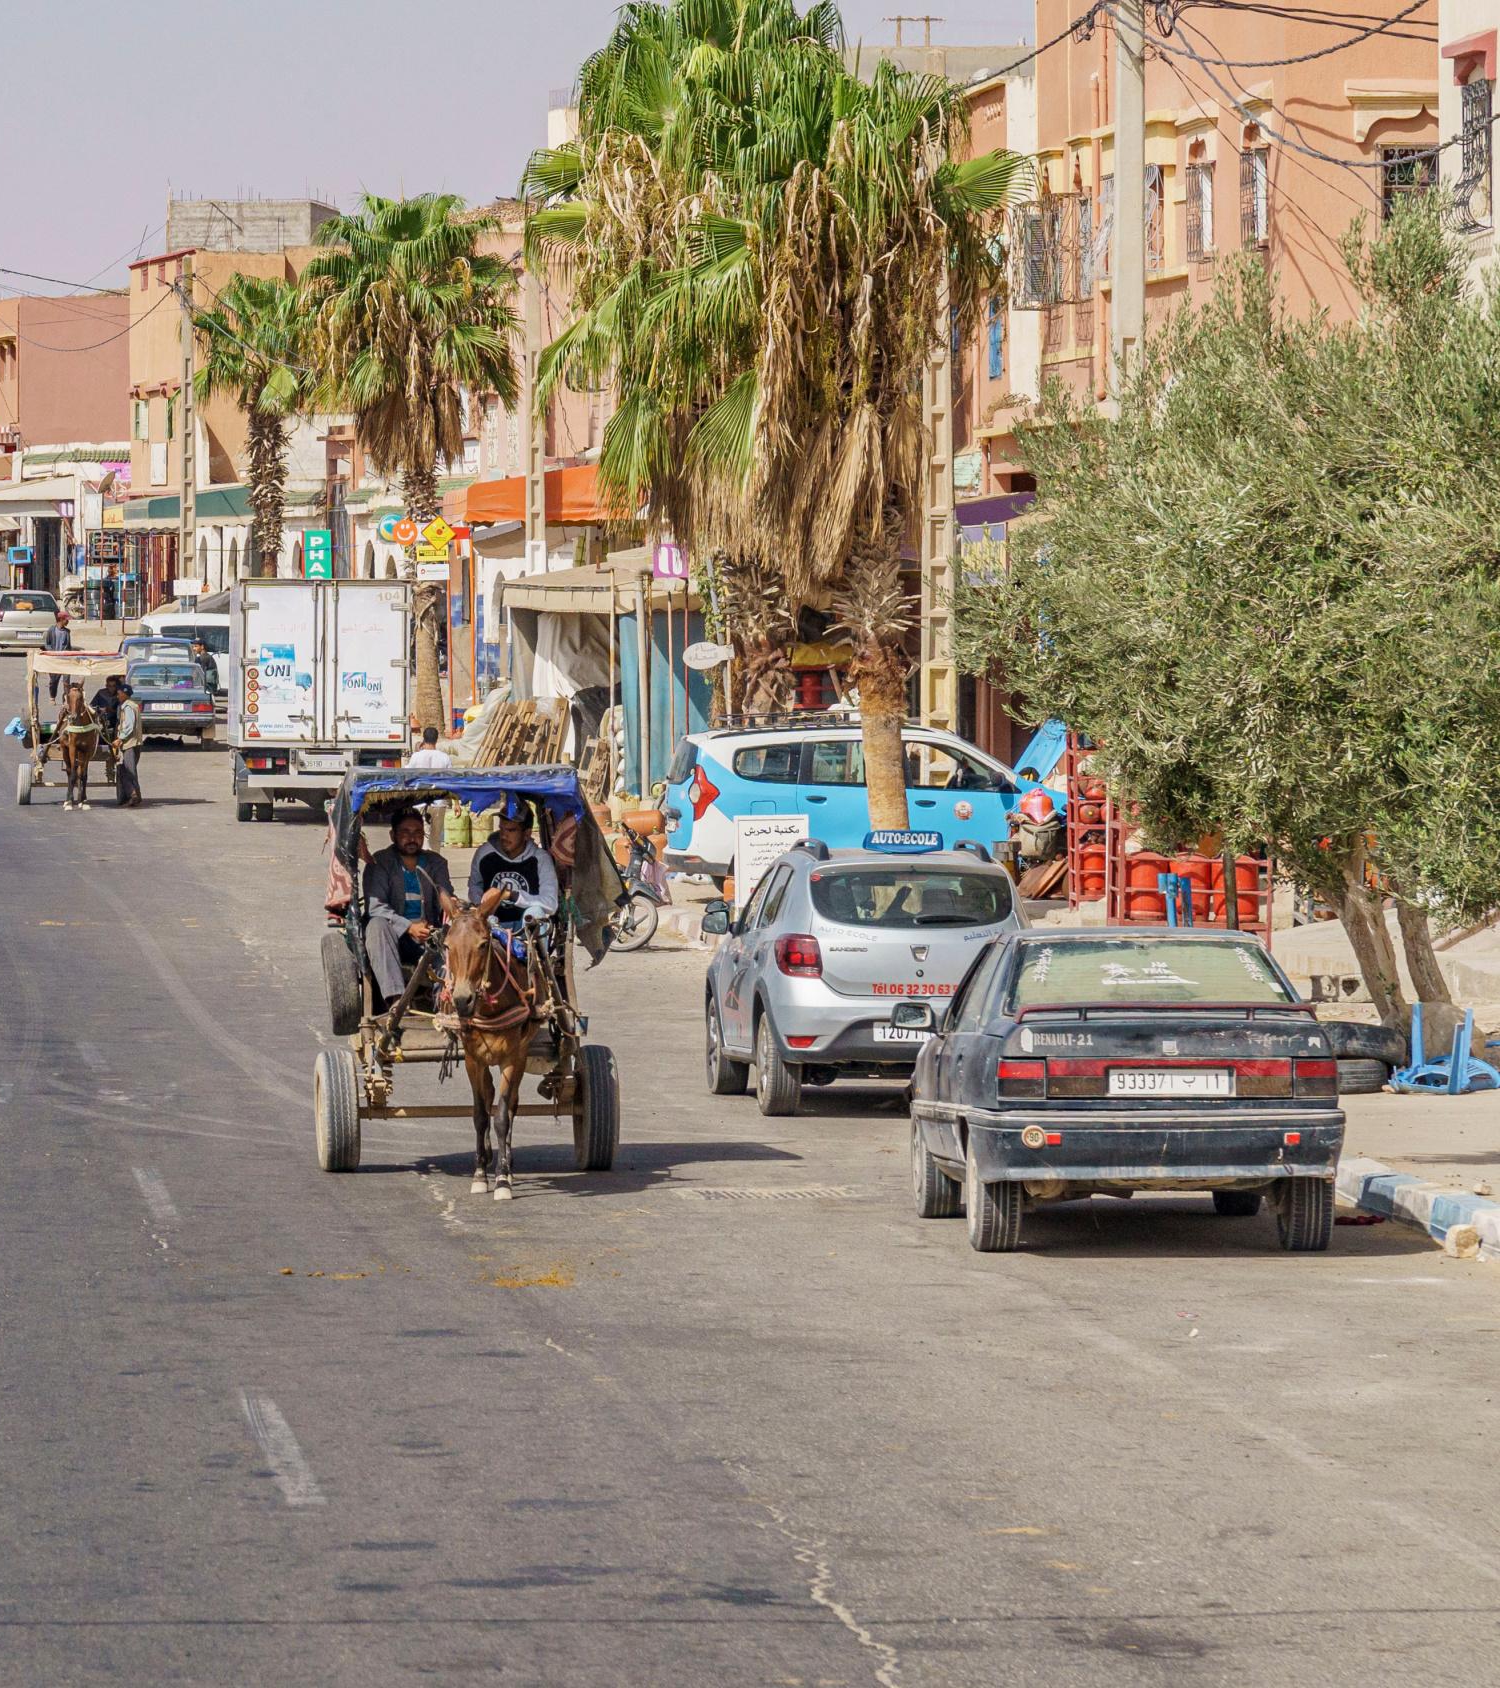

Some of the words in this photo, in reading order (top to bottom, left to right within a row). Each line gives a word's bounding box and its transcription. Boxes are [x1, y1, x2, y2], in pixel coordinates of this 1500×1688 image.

[377, 592, 400, 601] 104
[264, 664, 291, 678] ONI
[347, 678, 364, 689] ONI
[774, 825, 800, 835] مكتبة
[819, 926, 844, 936] AUTO
[848, 930, 877, 941] ECOLE
[872, 983, 886, 994] Tél
[890, 984, 904, 994] 06
[906, 984, 919, 994] 32
[922, 984, 935, 994] 30
[938, 984, 950, 994] 63
[1034, 1033, 1094, 1046] RENAULT-21
[1117, 1073, 1165, 1090] 93337
[1028, 1132, 1039, 1142] 90
